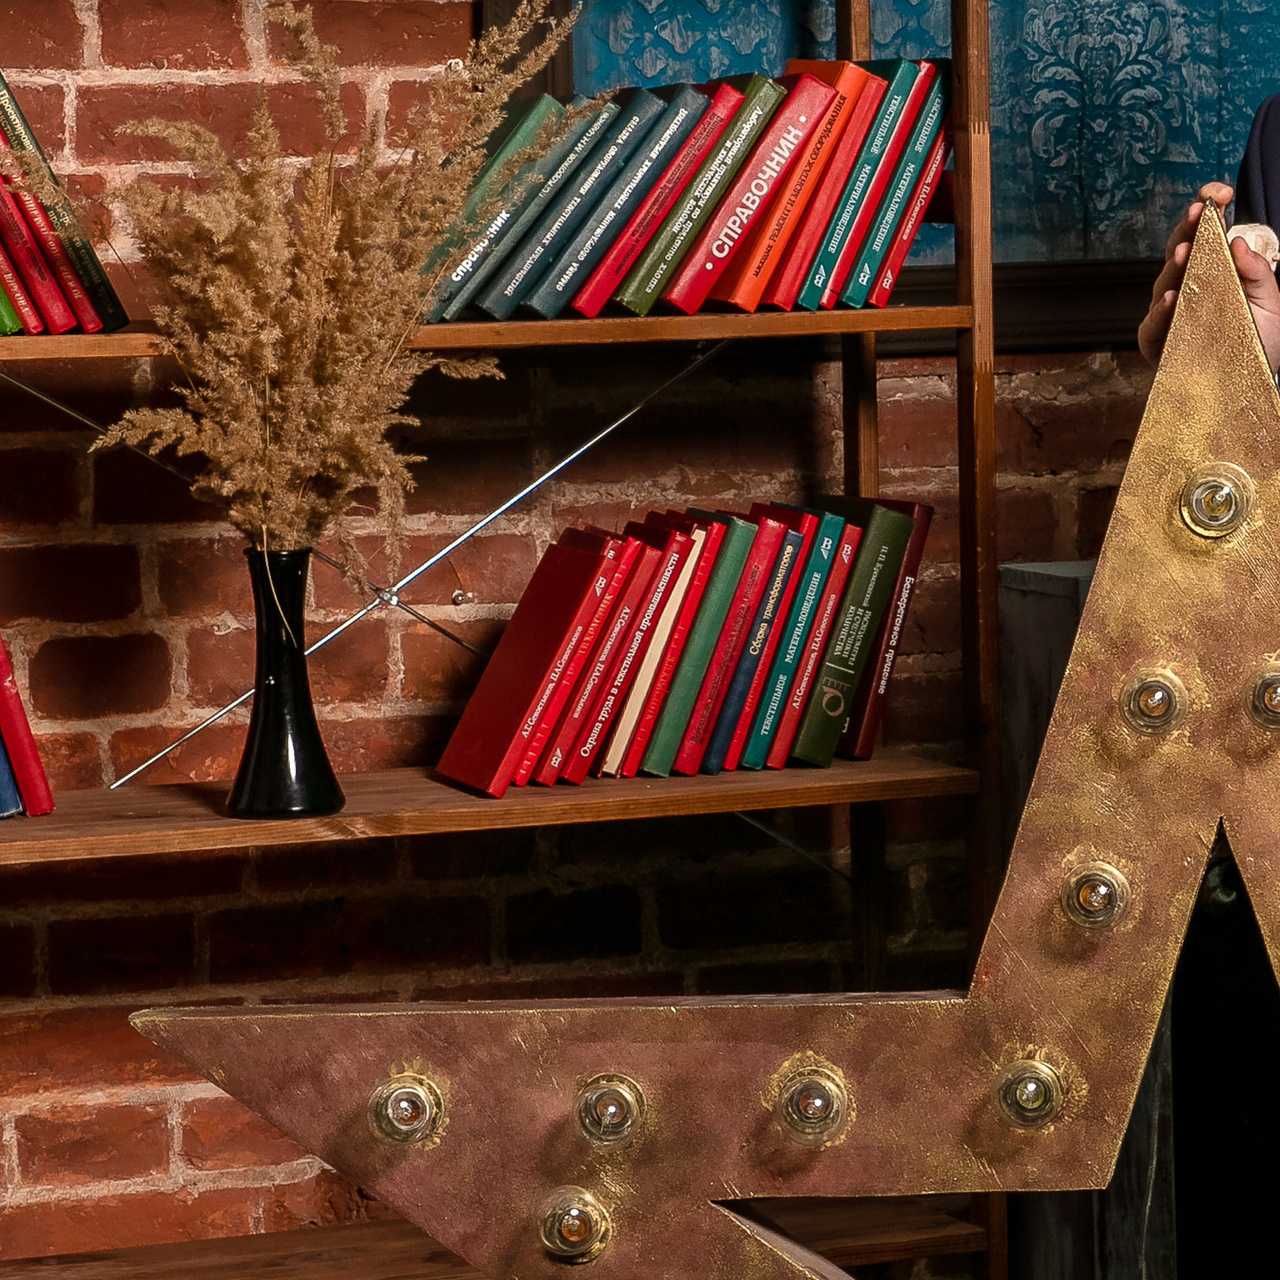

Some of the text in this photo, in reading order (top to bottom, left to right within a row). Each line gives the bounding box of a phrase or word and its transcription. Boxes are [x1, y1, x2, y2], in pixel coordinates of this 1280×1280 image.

[708, 121, 804, 263] СПРАВОЧНИК
[767, 206, 792, 243] РЕМОНТ
[788, 158, 815, 199] МОНТАЖ
[808, 93, 849, 161] ОБОРУДОВАНИЯ
[824, 92, 903, 255] ТЕКСТИЛЬНОЕ МАТЕРИАЛОВЕДЕНИЕ
[869, 161, 916, 252] МАТЕРИАЛОВЕДЕНИЕ
[578, 720, 604, 758] Охрана
[596, 693, 617, 723] труда
[611, 630, 644, 686] текстильной
[637, 551, 682, 631] промышленности
[747, 620, 770, 656] Сборка
[756, 543, 799, 621] трансформаторов
[759, 570, 823, 736] ТЕКСТИЛЬНОЕ МАТЕРИАЛОВЕДЕНИЕ
